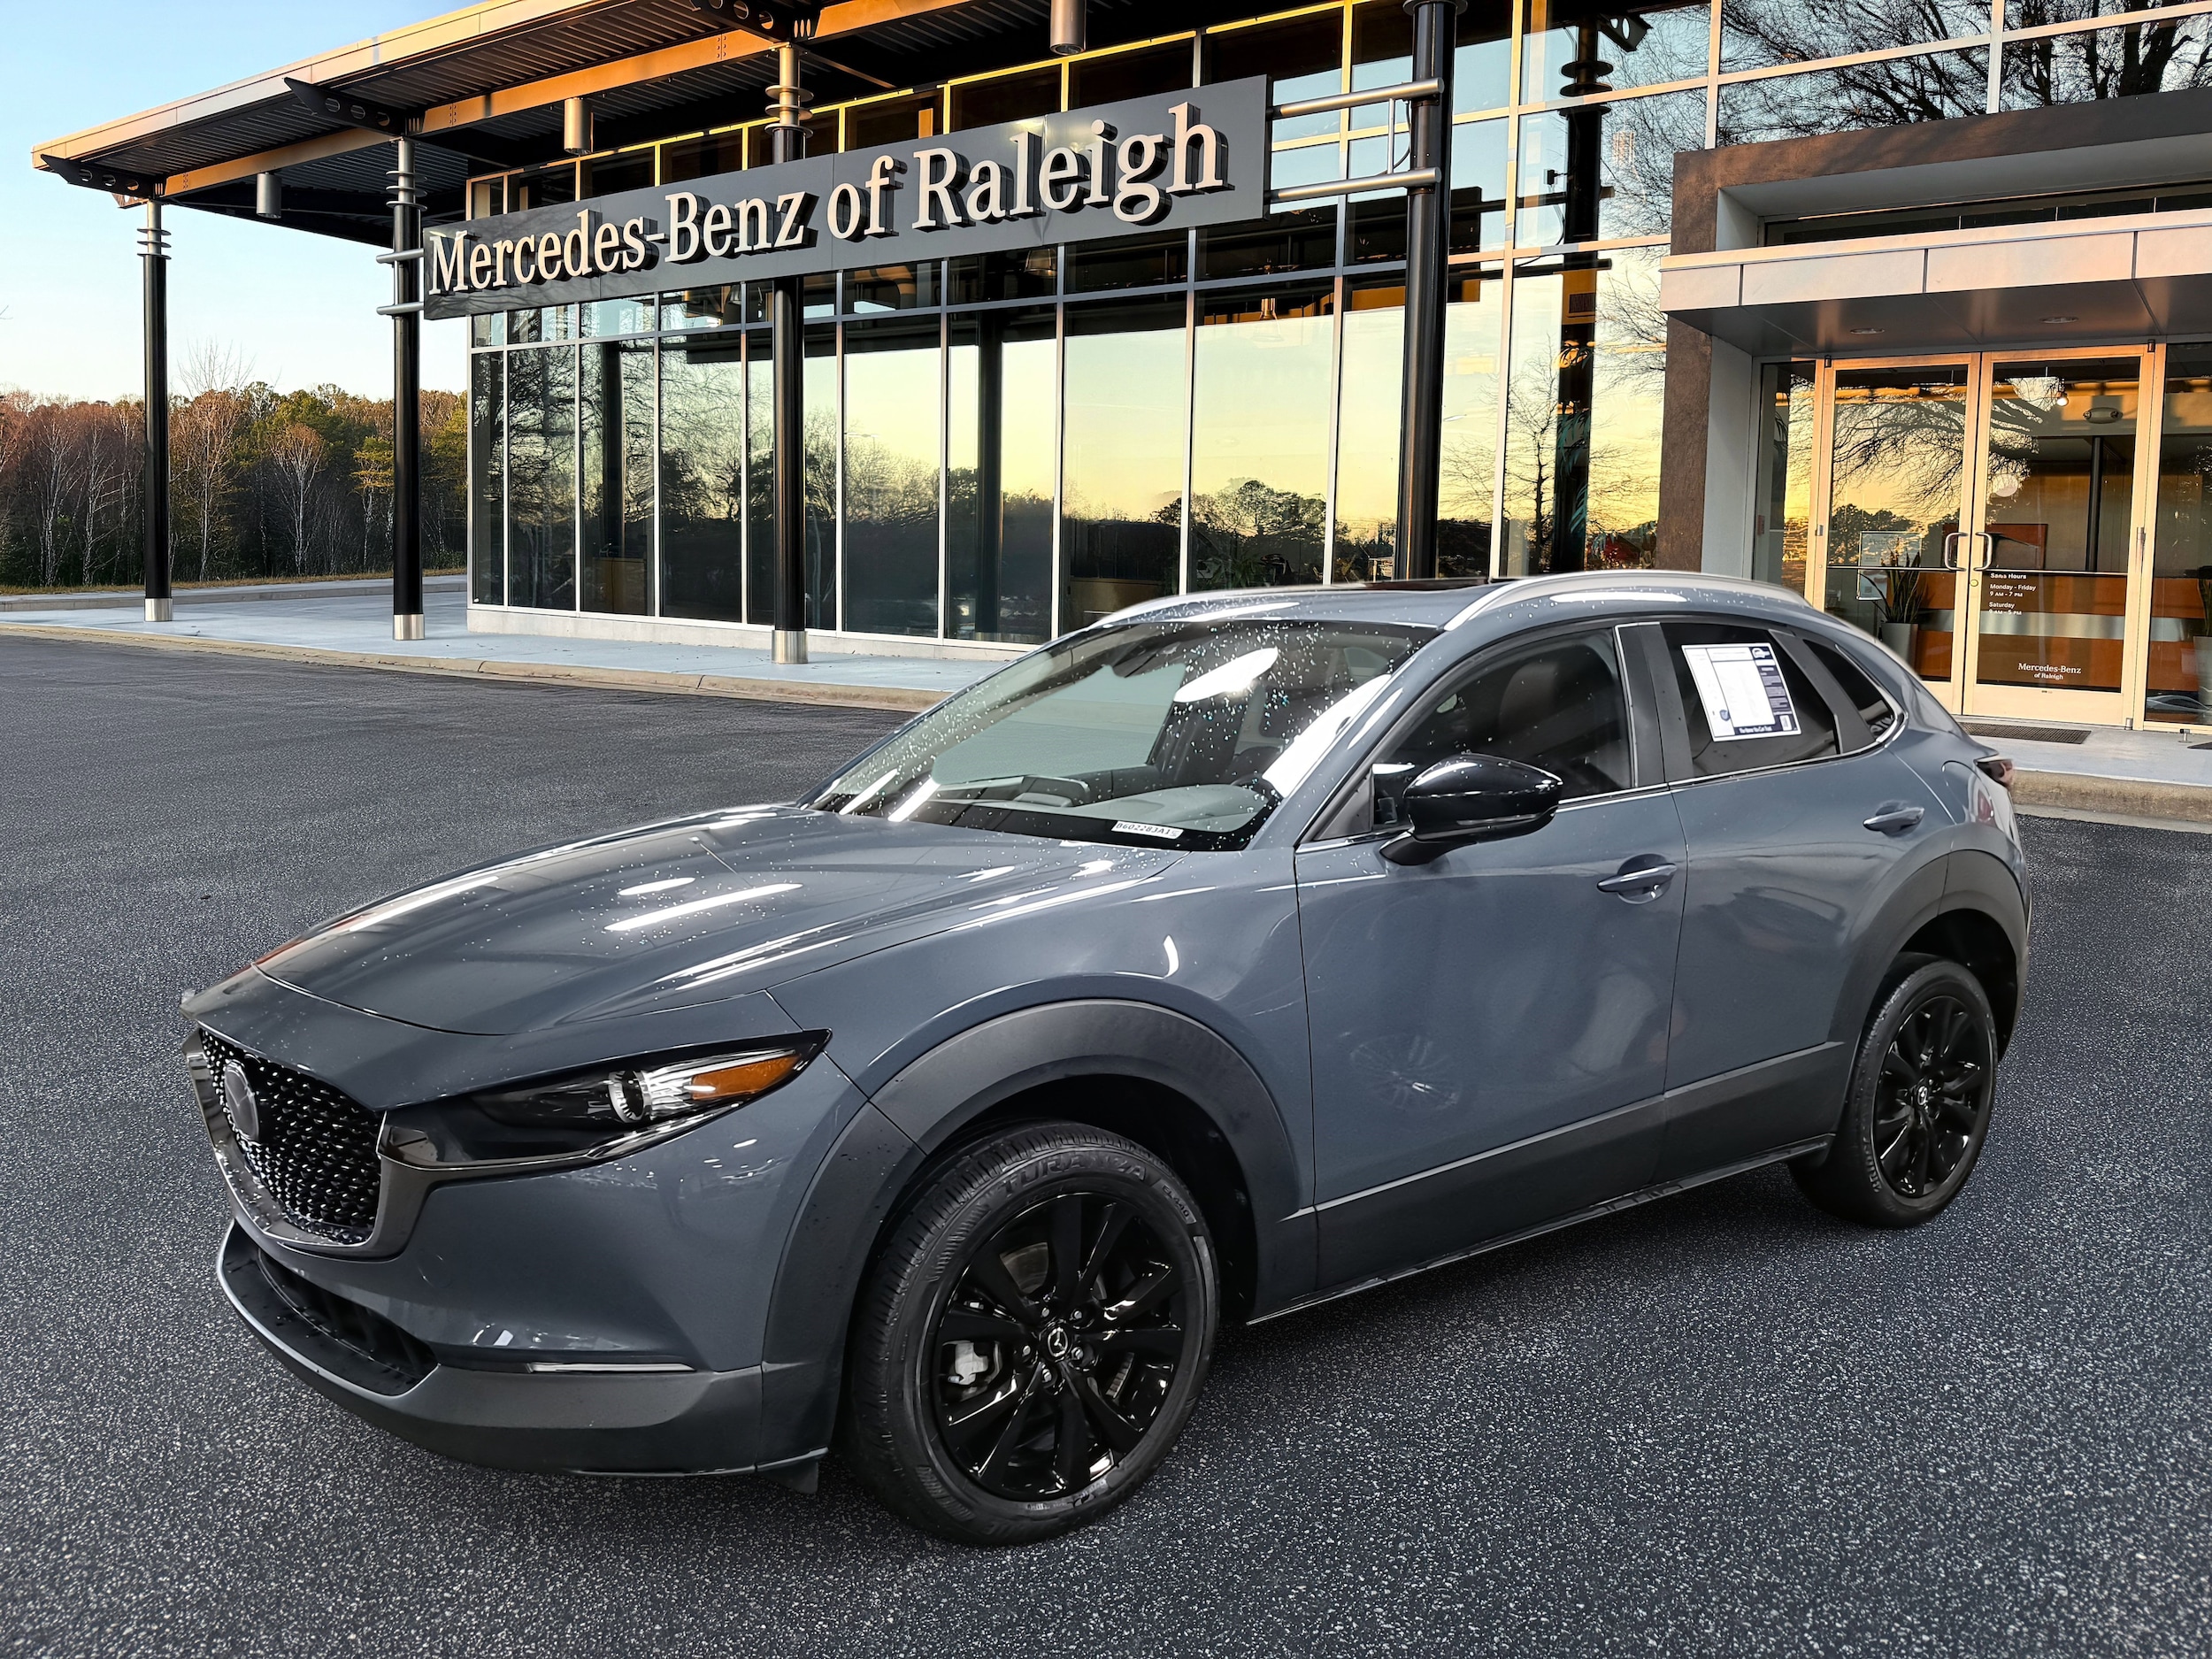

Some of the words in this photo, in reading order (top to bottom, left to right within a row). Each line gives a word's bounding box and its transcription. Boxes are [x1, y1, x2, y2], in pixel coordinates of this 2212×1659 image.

[429, 191, 807, 296] Mercedes-Benz
[827, 155, 895, 239] of
[912, 101, 1225, 228] Raleigh
[2018, 663, 2081, 673] Mercedes-Benz
[999, 1152, 1148, 1198] TURANZA
